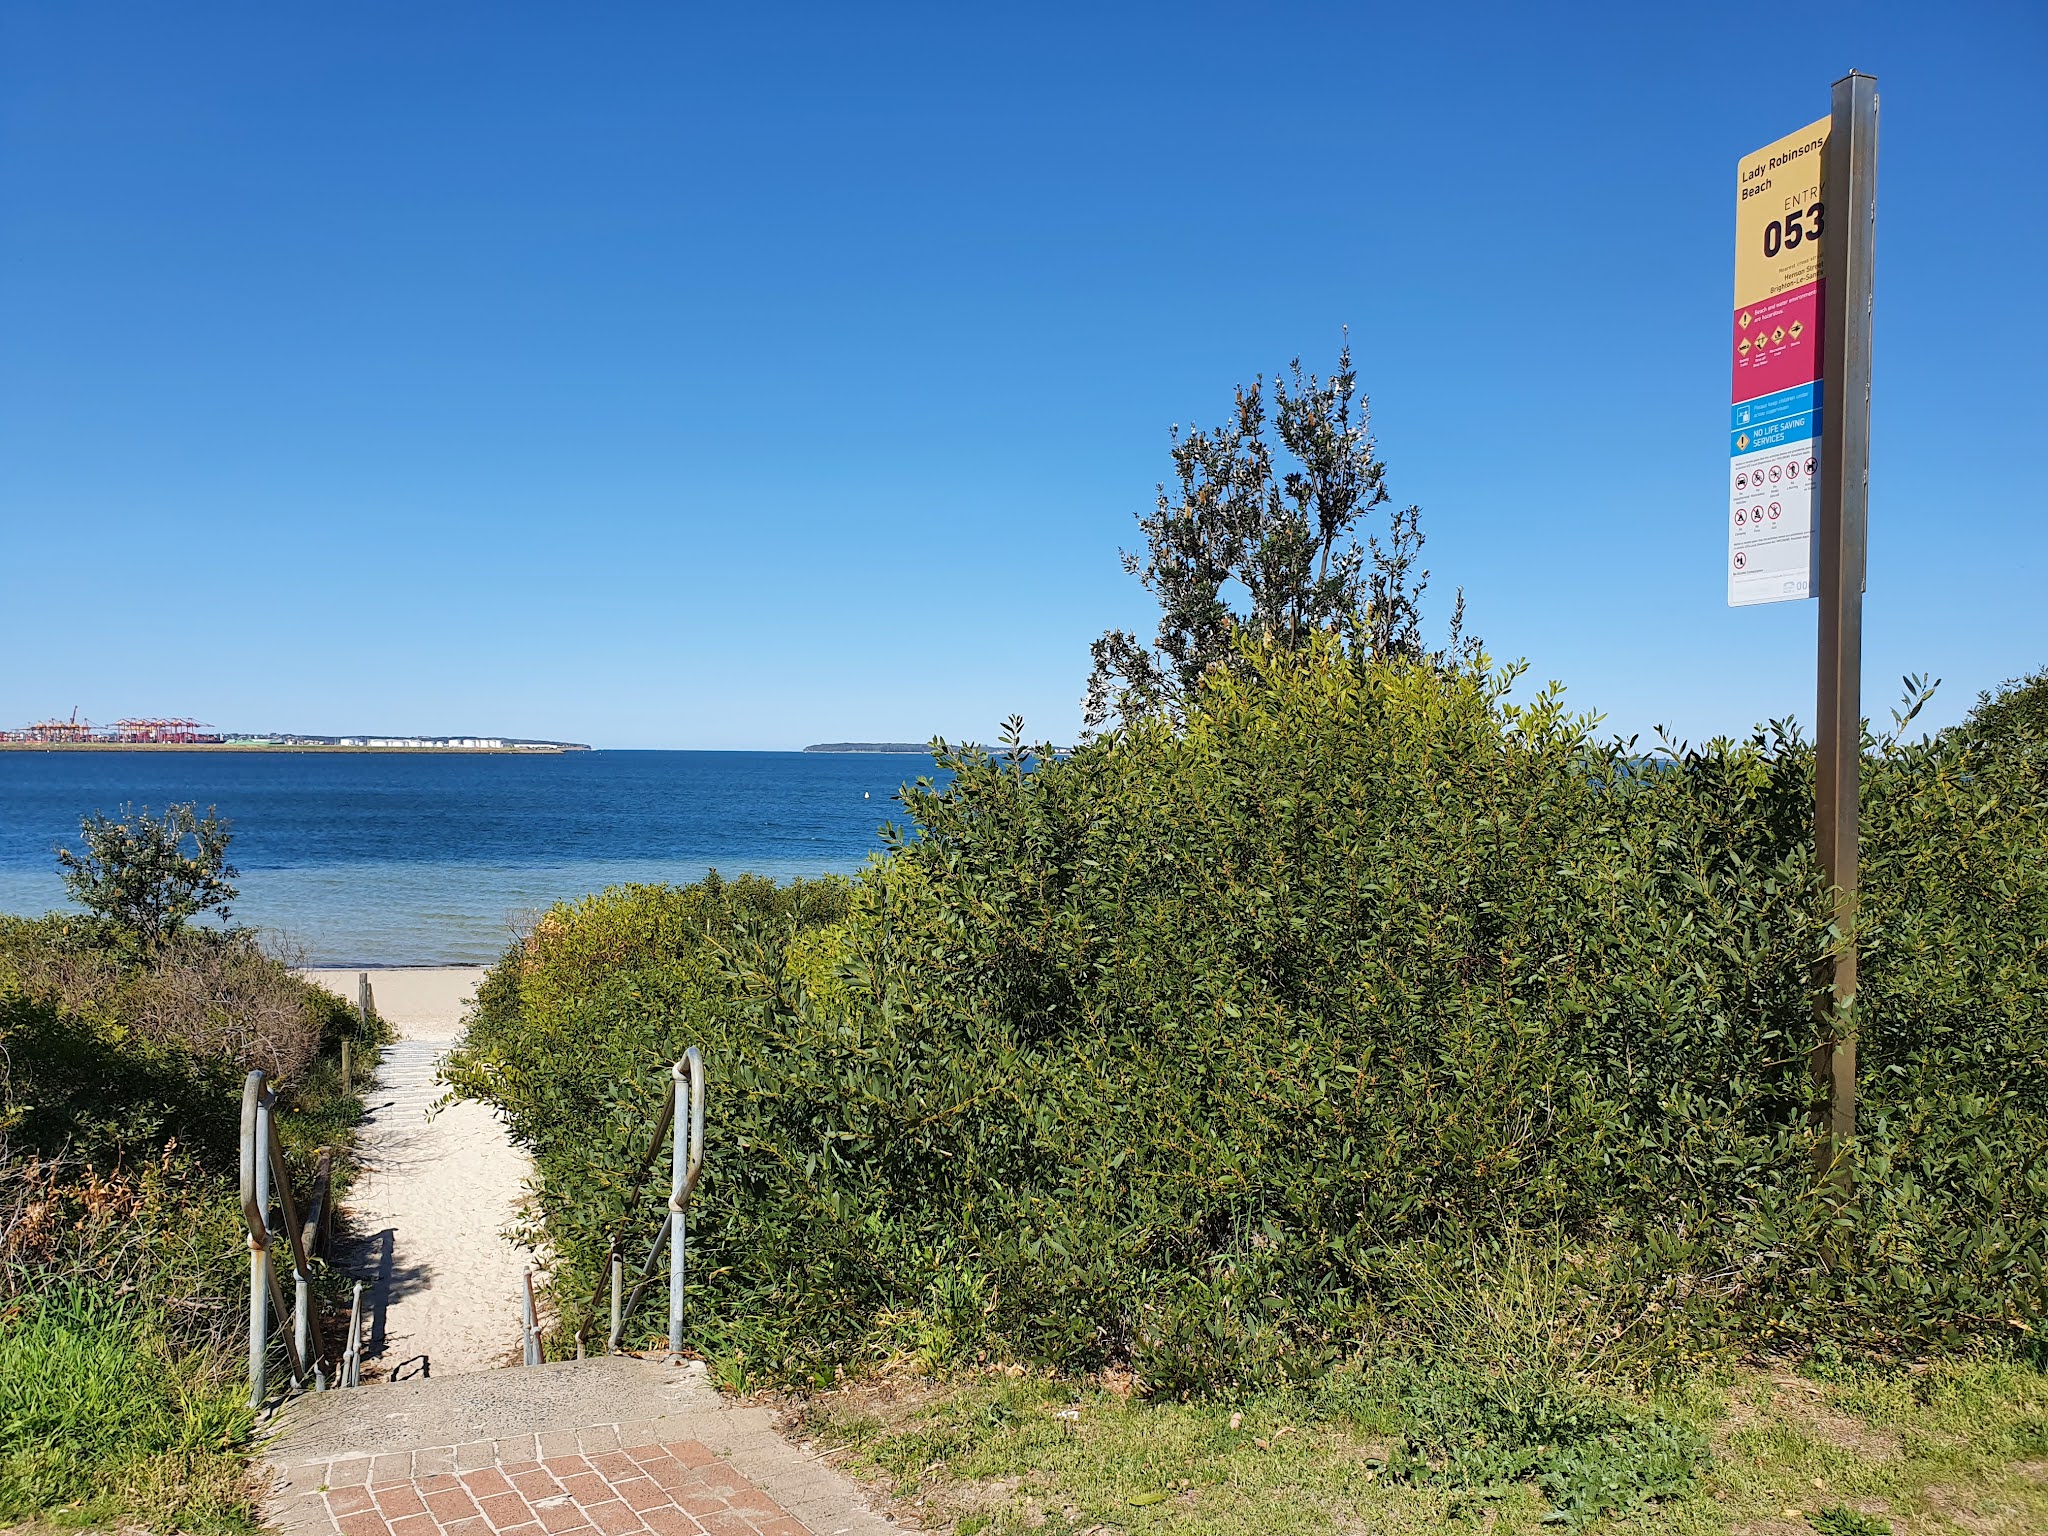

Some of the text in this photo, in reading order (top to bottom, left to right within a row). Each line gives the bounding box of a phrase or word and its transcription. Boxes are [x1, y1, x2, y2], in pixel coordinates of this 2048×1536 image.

[1742, 136, 1824, 183] Lady Robinsons
[1742, 178, 1772, 200] Beach
[1784, 181, 1825, 211] ENTRY
[1763, 202, 1825, 258] 053
[1784, 268, 1806, 281] Henson
[1753, 417, 1806, 438] NO LIFE SAVING
[1752, 432, 1785, 448] SERVICES
